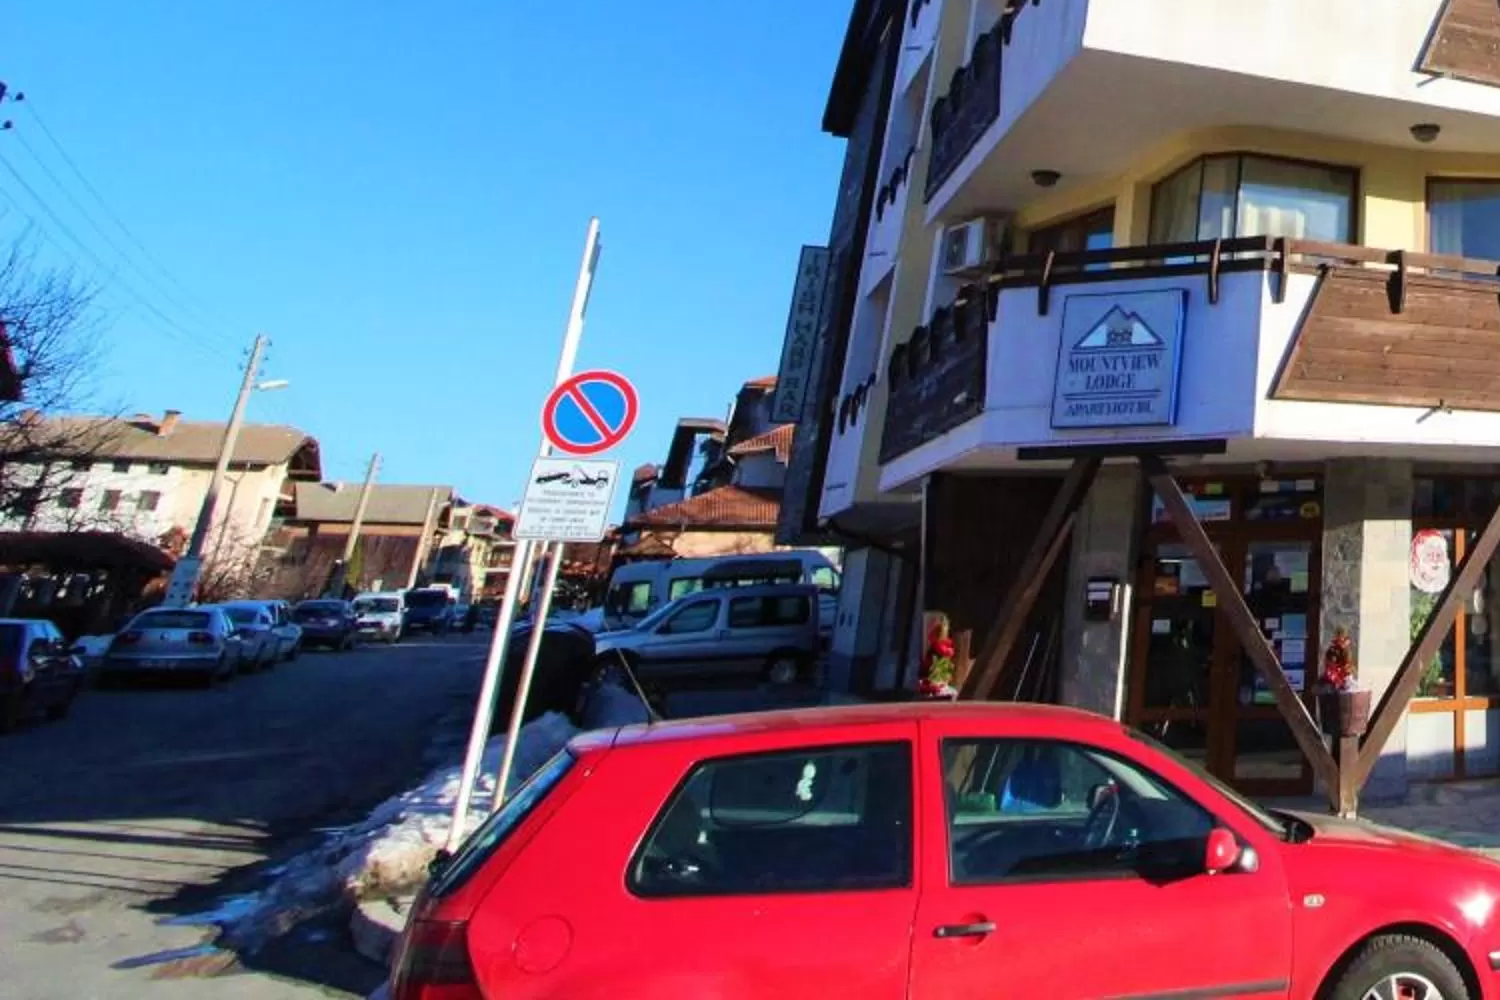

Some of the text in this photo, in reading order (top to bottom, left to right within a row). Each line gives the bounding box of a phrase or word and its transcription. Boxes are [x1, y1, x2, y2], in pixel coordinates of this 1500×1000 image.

[1068, 354, 1159, 373] MOUNTVIEW
[1085, 373, 1136, 390] LODGE
[1065, 401, 1154, 416] APARTHOTEL
